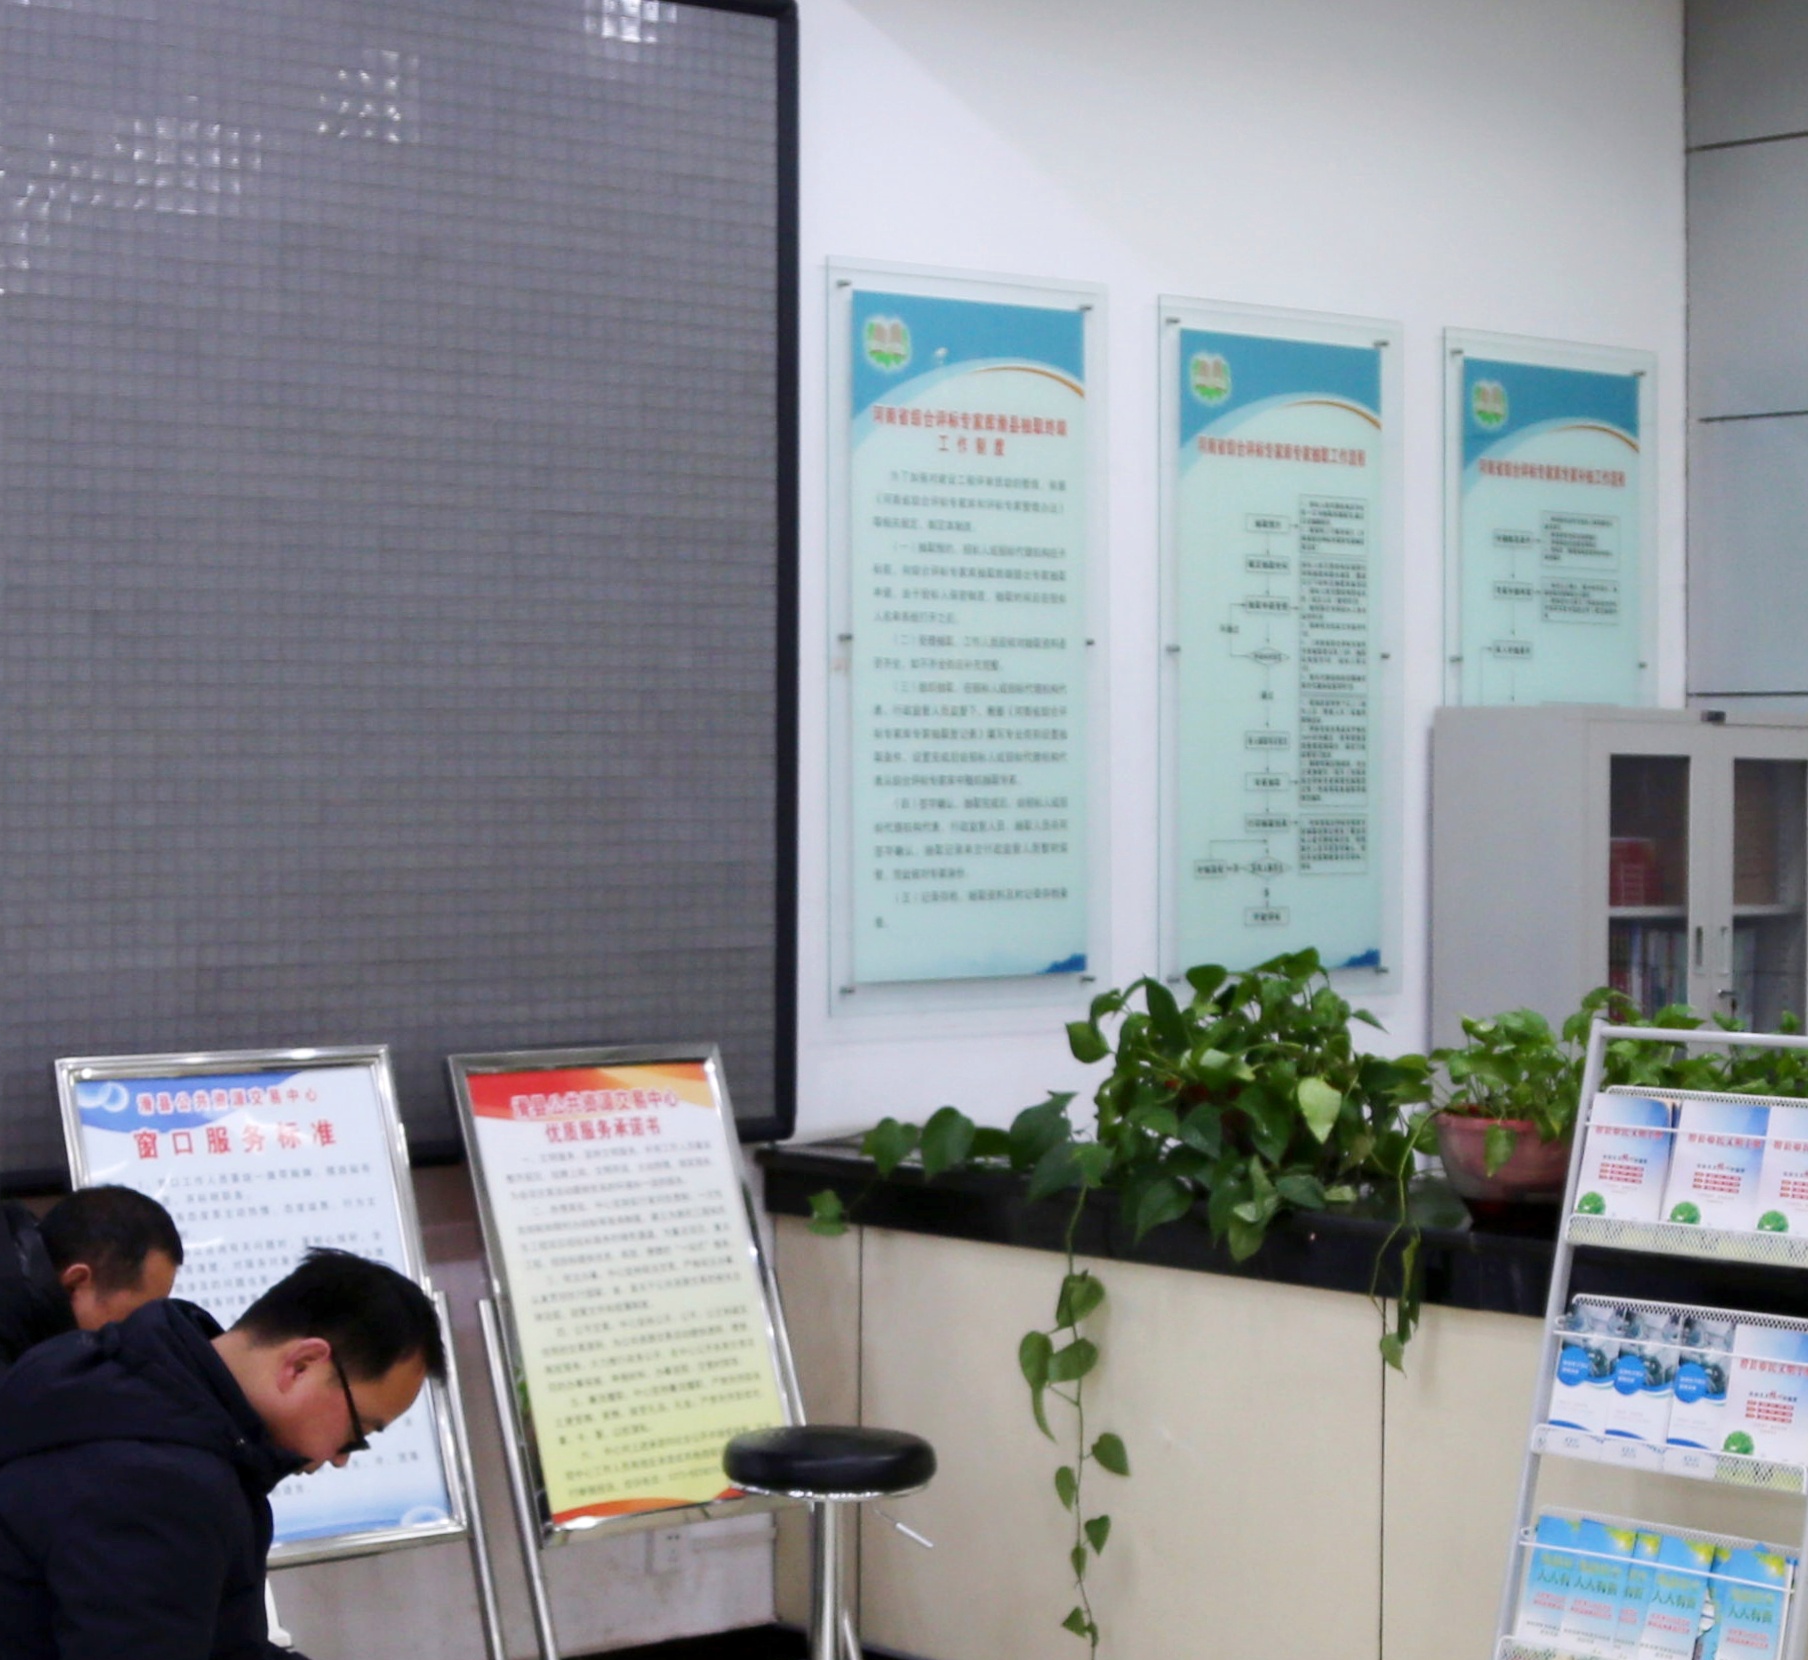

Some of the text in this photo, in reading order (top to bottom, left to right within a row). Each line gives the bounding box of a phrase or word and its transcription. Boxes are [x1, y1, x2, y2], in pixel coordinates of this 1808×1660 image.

[133, 1119, 336, 1161] 窗口服务标准
[545, 1116, 661, 1143] 优质服务承诺书
